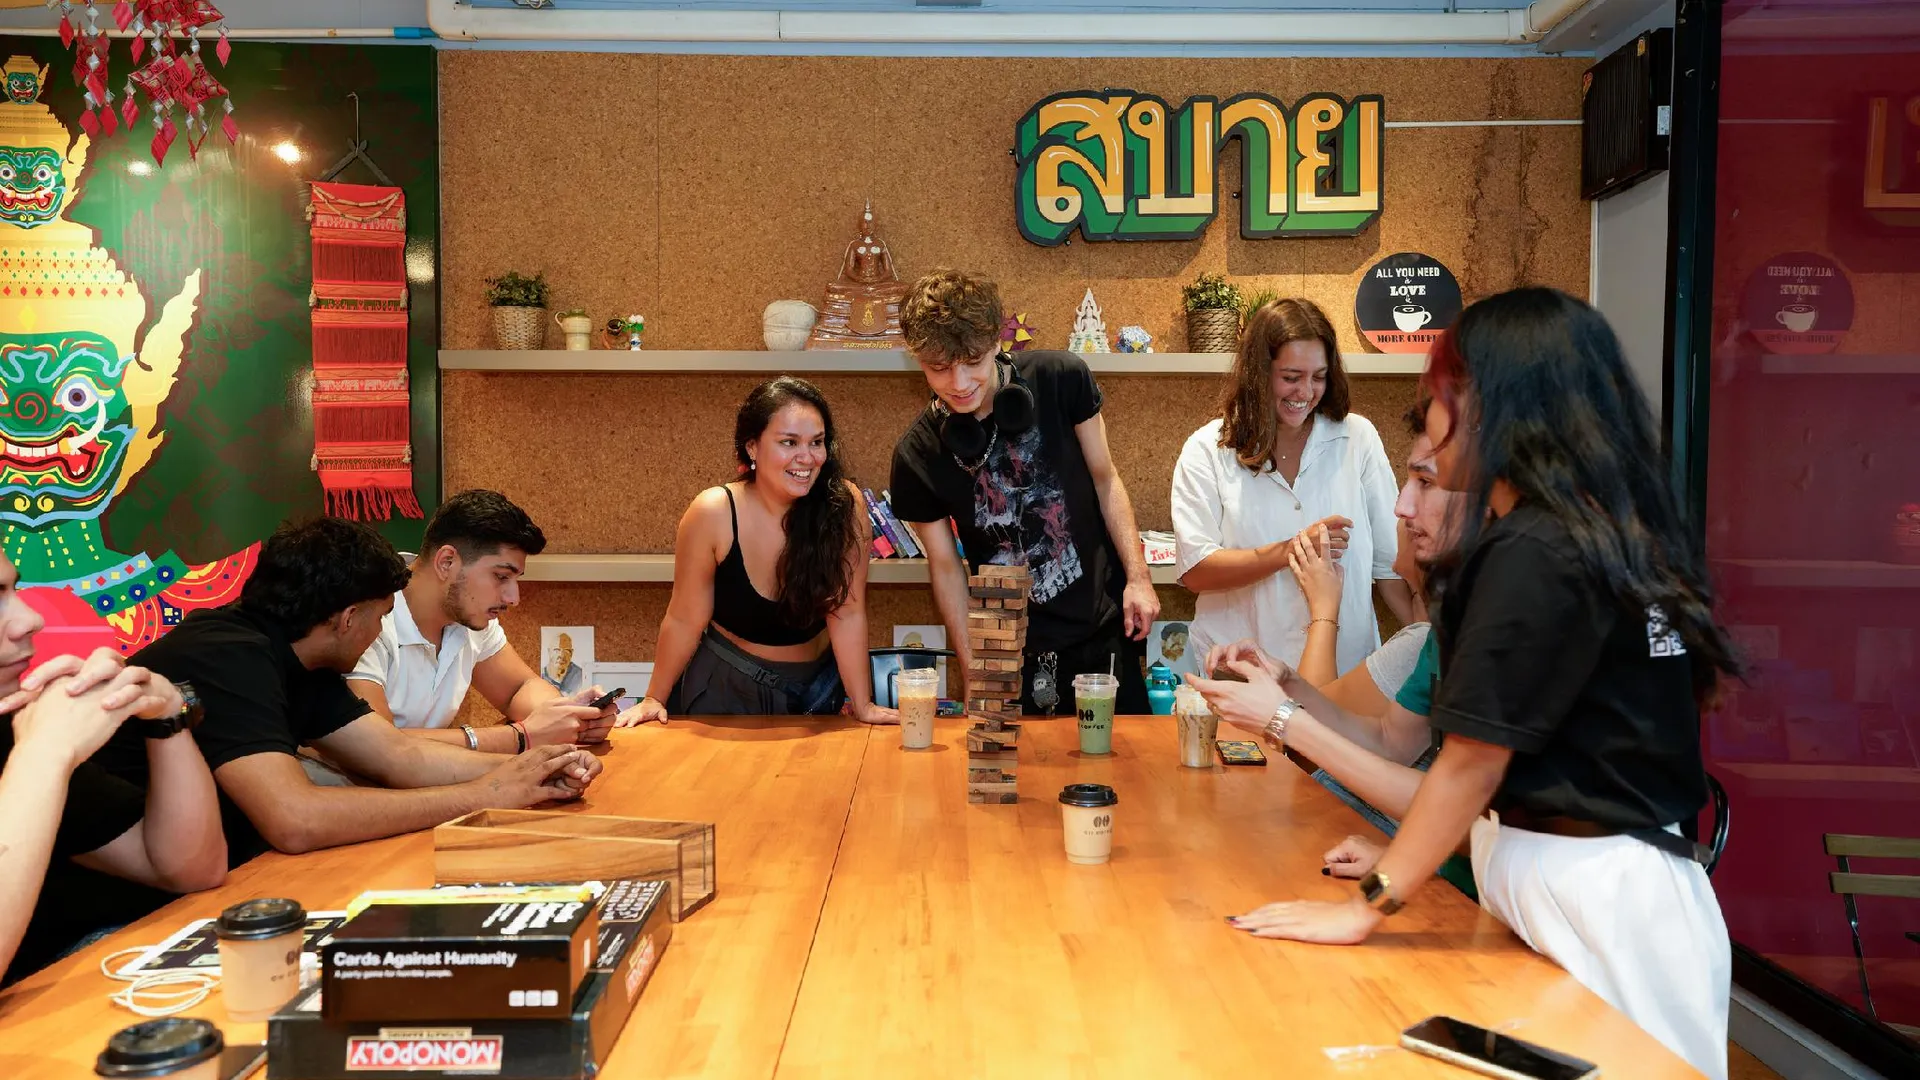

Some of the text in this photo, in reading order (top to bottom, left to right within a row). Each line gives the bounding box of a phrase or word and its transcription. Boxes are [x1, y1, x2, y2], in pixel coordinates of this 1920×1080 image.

[1035, 96, 1379, 224] สบาย
[1376, 267, 1440, 278] ALL YOU NEED
[1389, 285, 1426, 296] LOVE
[1377, 334, 1437, 343] MORE COFF
[333, 950, 517, 968] Cards Against Humanity
[351, 1041, 496, 1065] MONOPOLY
